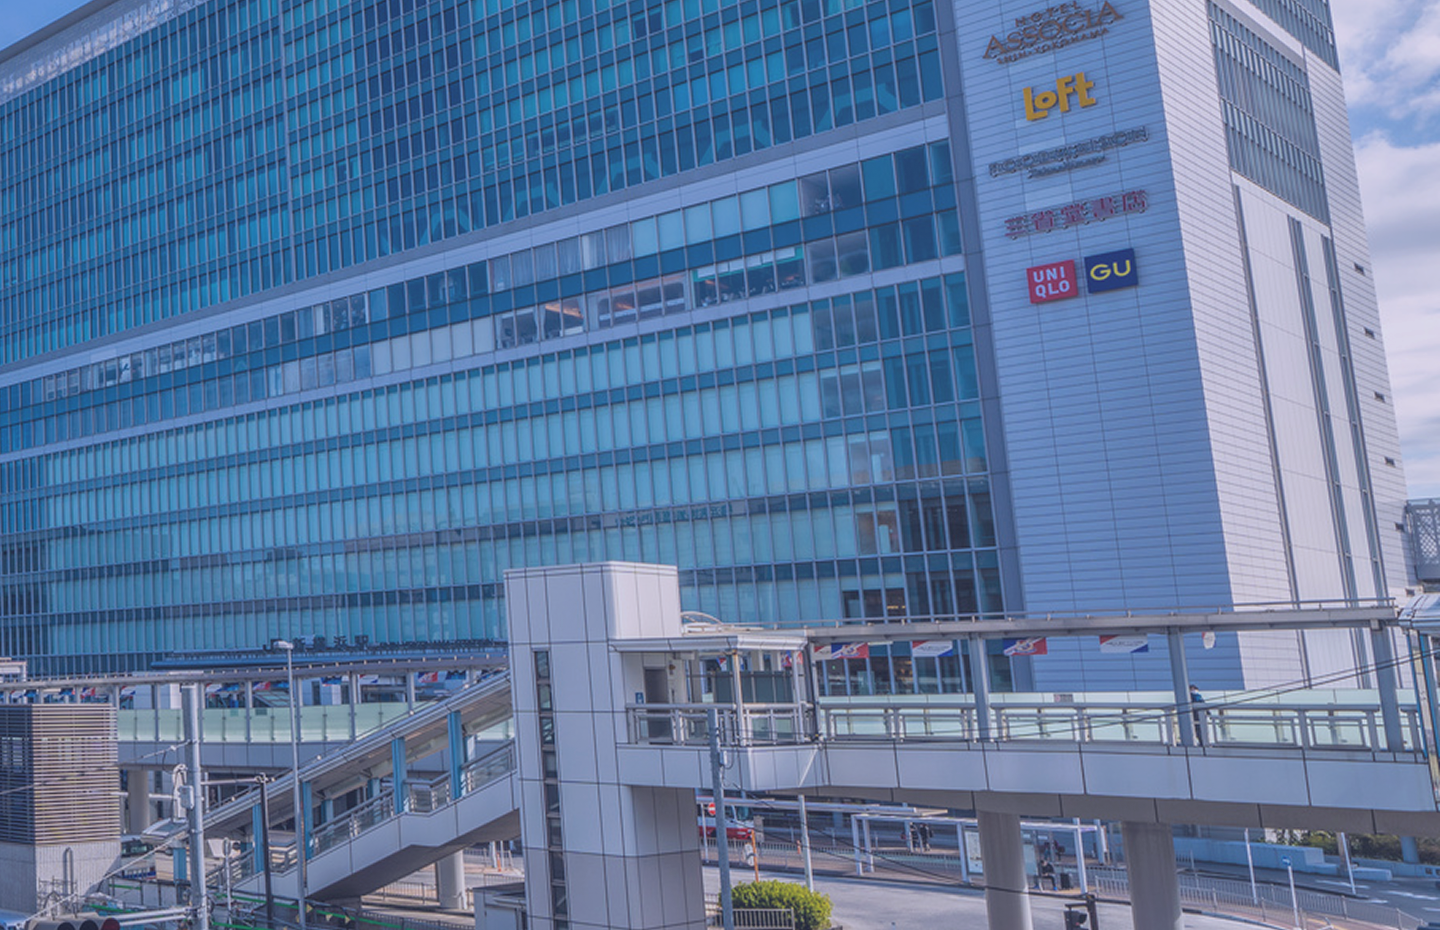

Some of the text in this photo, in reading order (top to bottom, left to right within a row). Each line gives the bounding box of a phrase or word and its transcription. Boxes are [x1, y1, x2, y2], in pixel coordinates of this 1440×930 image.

[1015, 0, 1081, 27] HOTEL
[983, 1, 1124, 59] ASSOCIA
[1033, 266, 1066, 283] UNI
[1090, 259, 1132, 281] GU
[1035, 279, 1071, 298] QLO
